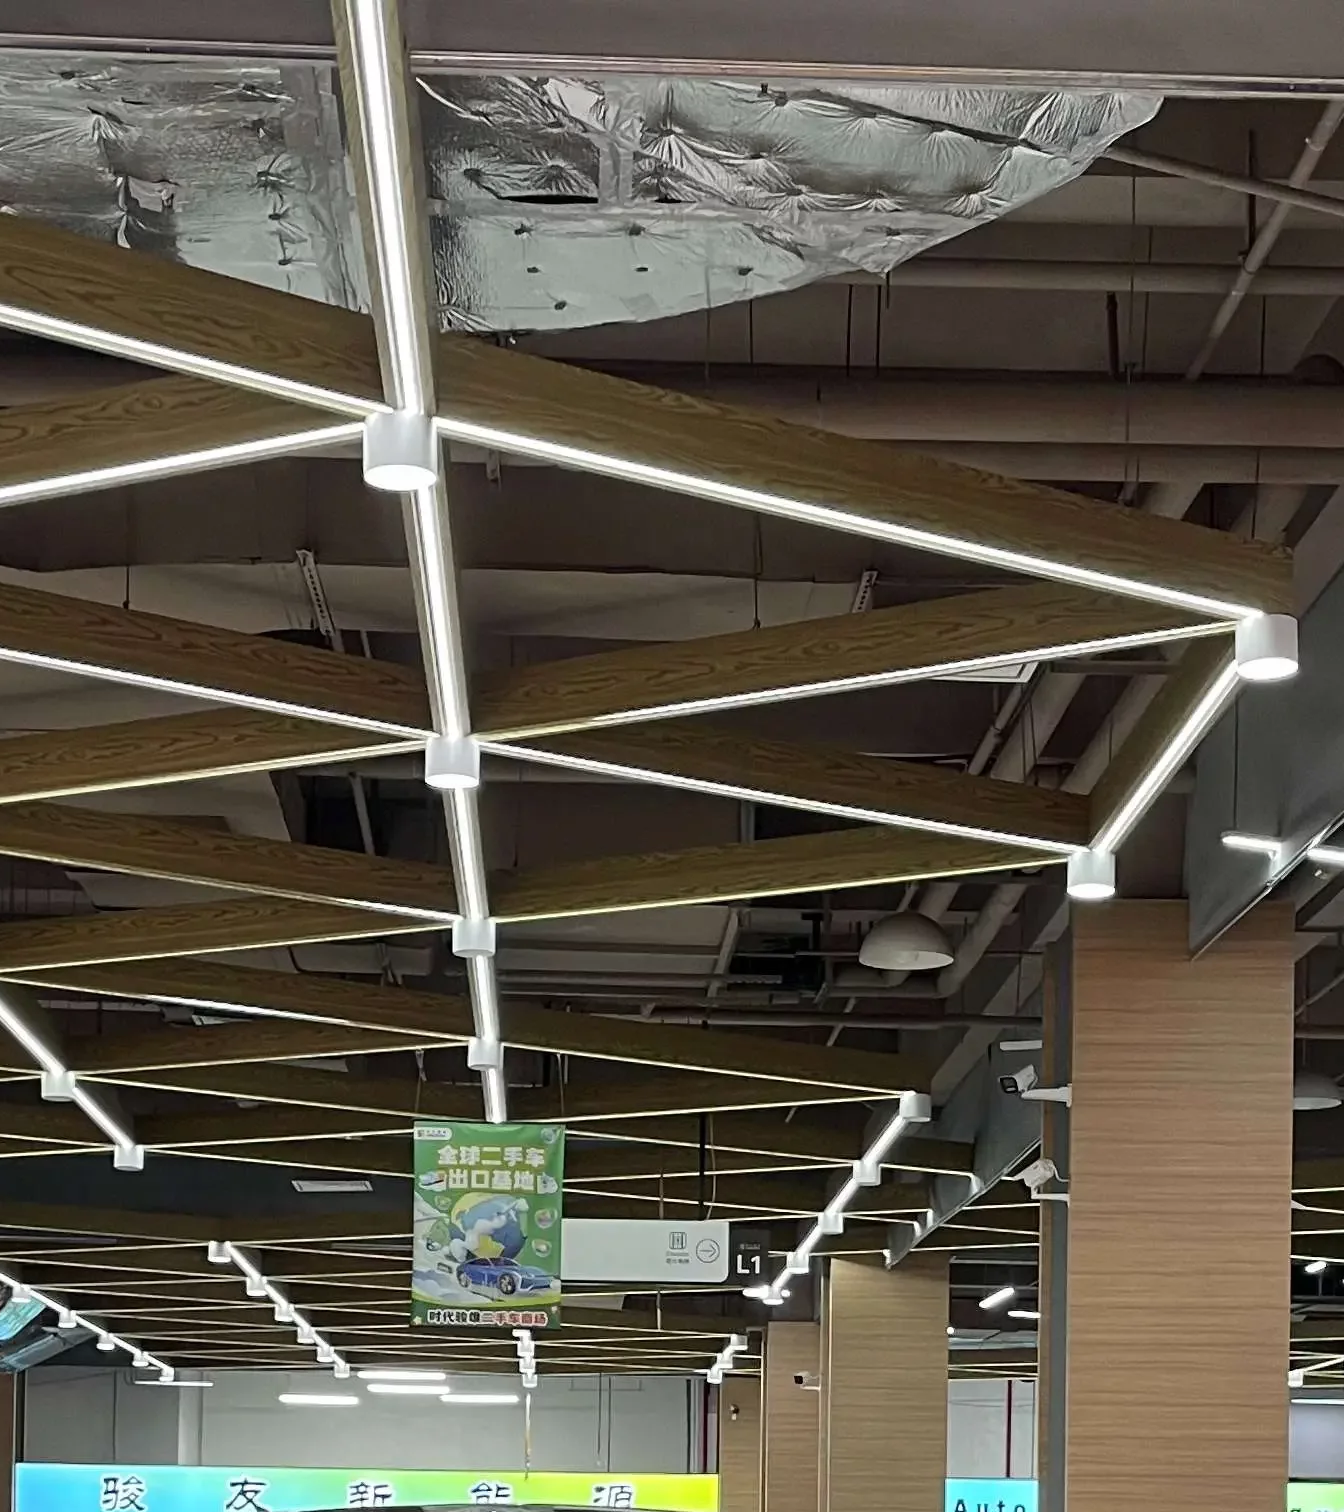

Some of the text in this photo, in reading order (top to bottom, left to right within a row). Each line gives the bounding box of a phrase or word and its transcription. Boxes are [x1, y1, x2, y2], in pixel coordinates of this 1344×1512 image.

[438, 1145, 545, 1167] 全球二手车
[448, 1170, 534, 1190] 出口基地
[737, 1254, 761, 1274] L1
